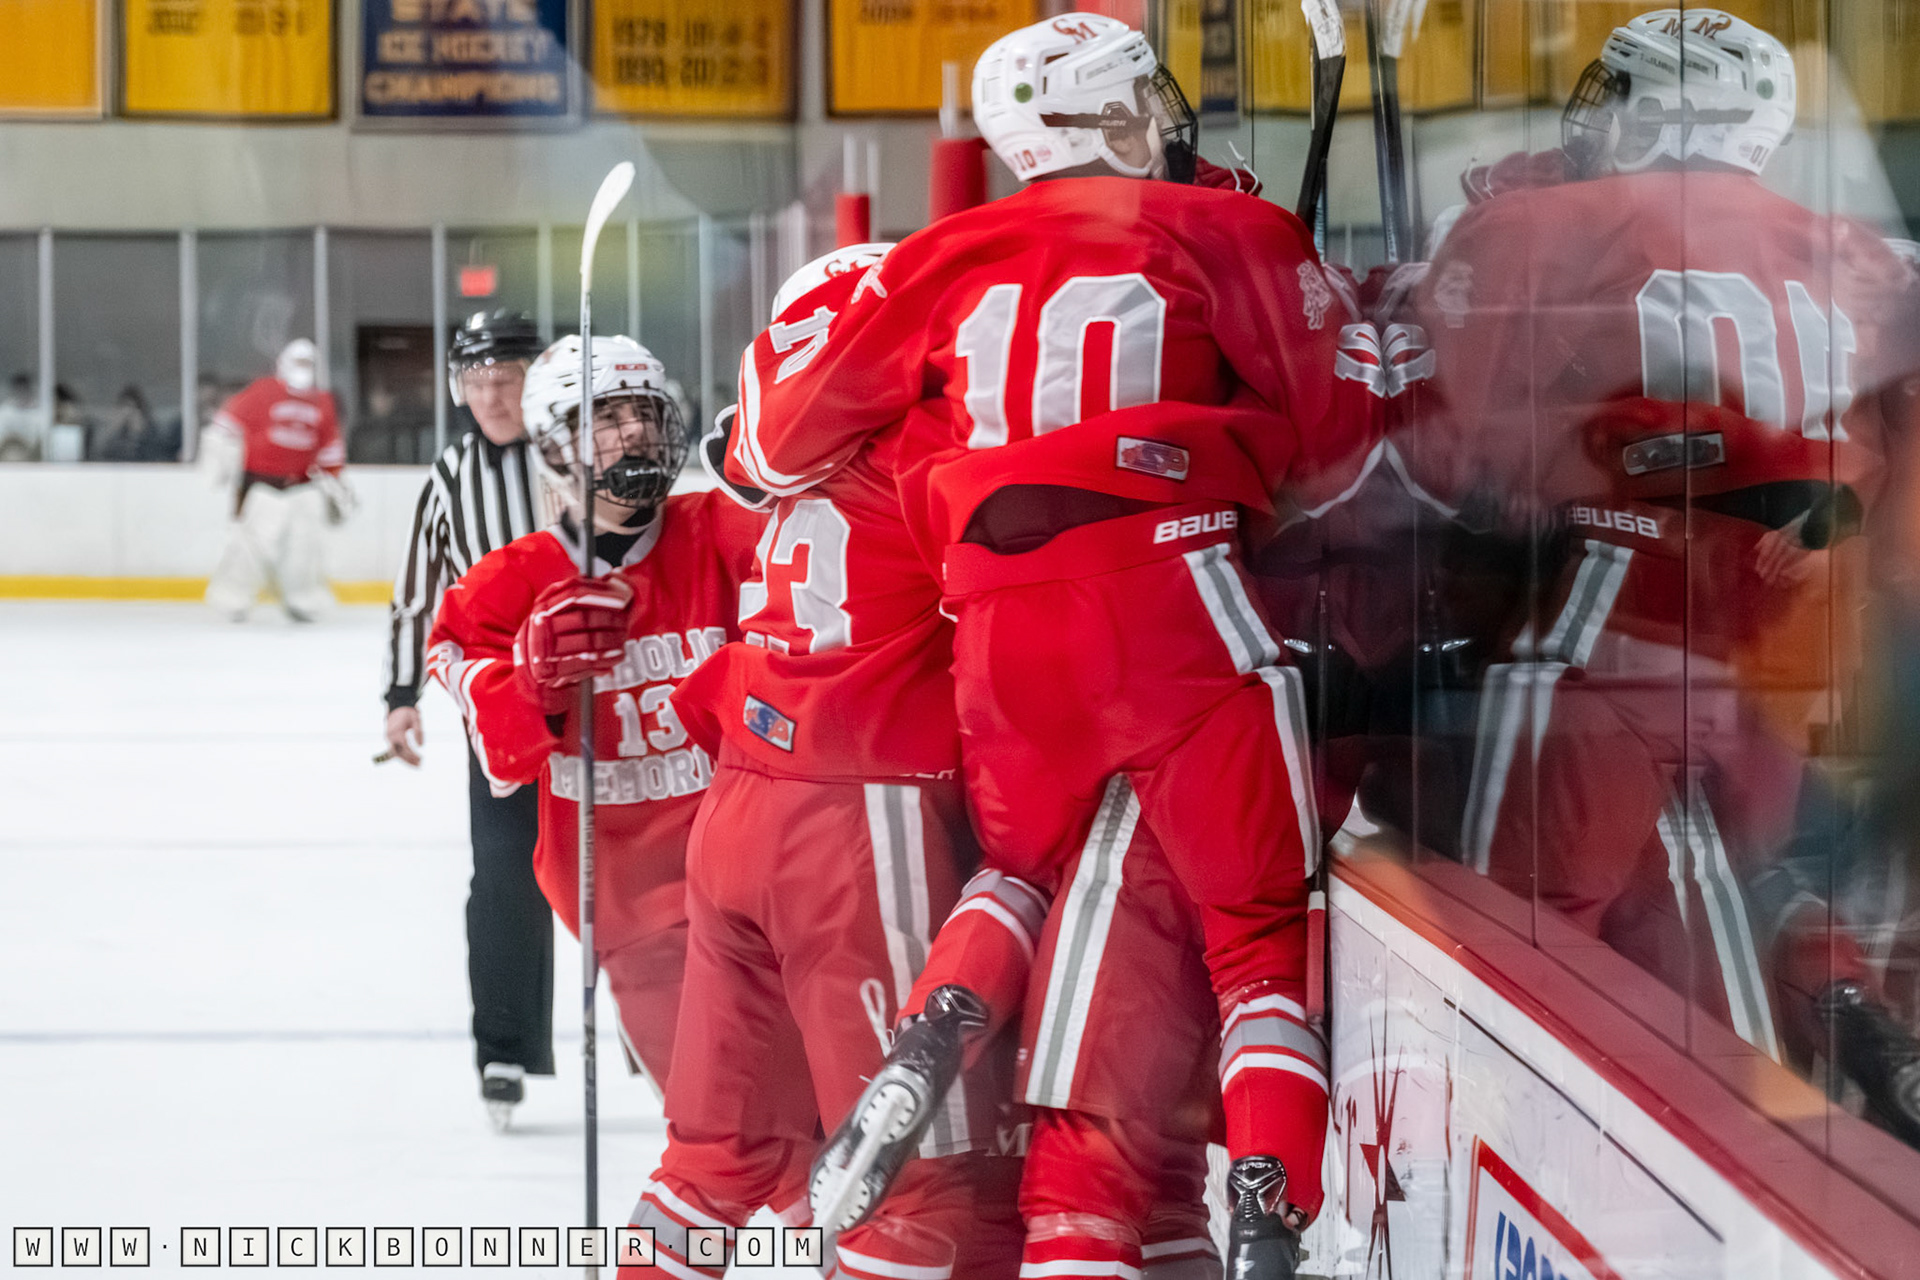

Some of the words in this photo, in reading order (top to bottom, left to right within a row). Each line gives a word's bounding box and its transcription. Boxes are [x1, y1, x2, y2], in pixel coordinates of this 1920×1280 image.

[365, 70, 560, 105] CHAMPIONS
[955, 273, 1167, 450] 10
[1153, 510, 1238, 544] BAUE
[614, 683, 688, 757] 13
